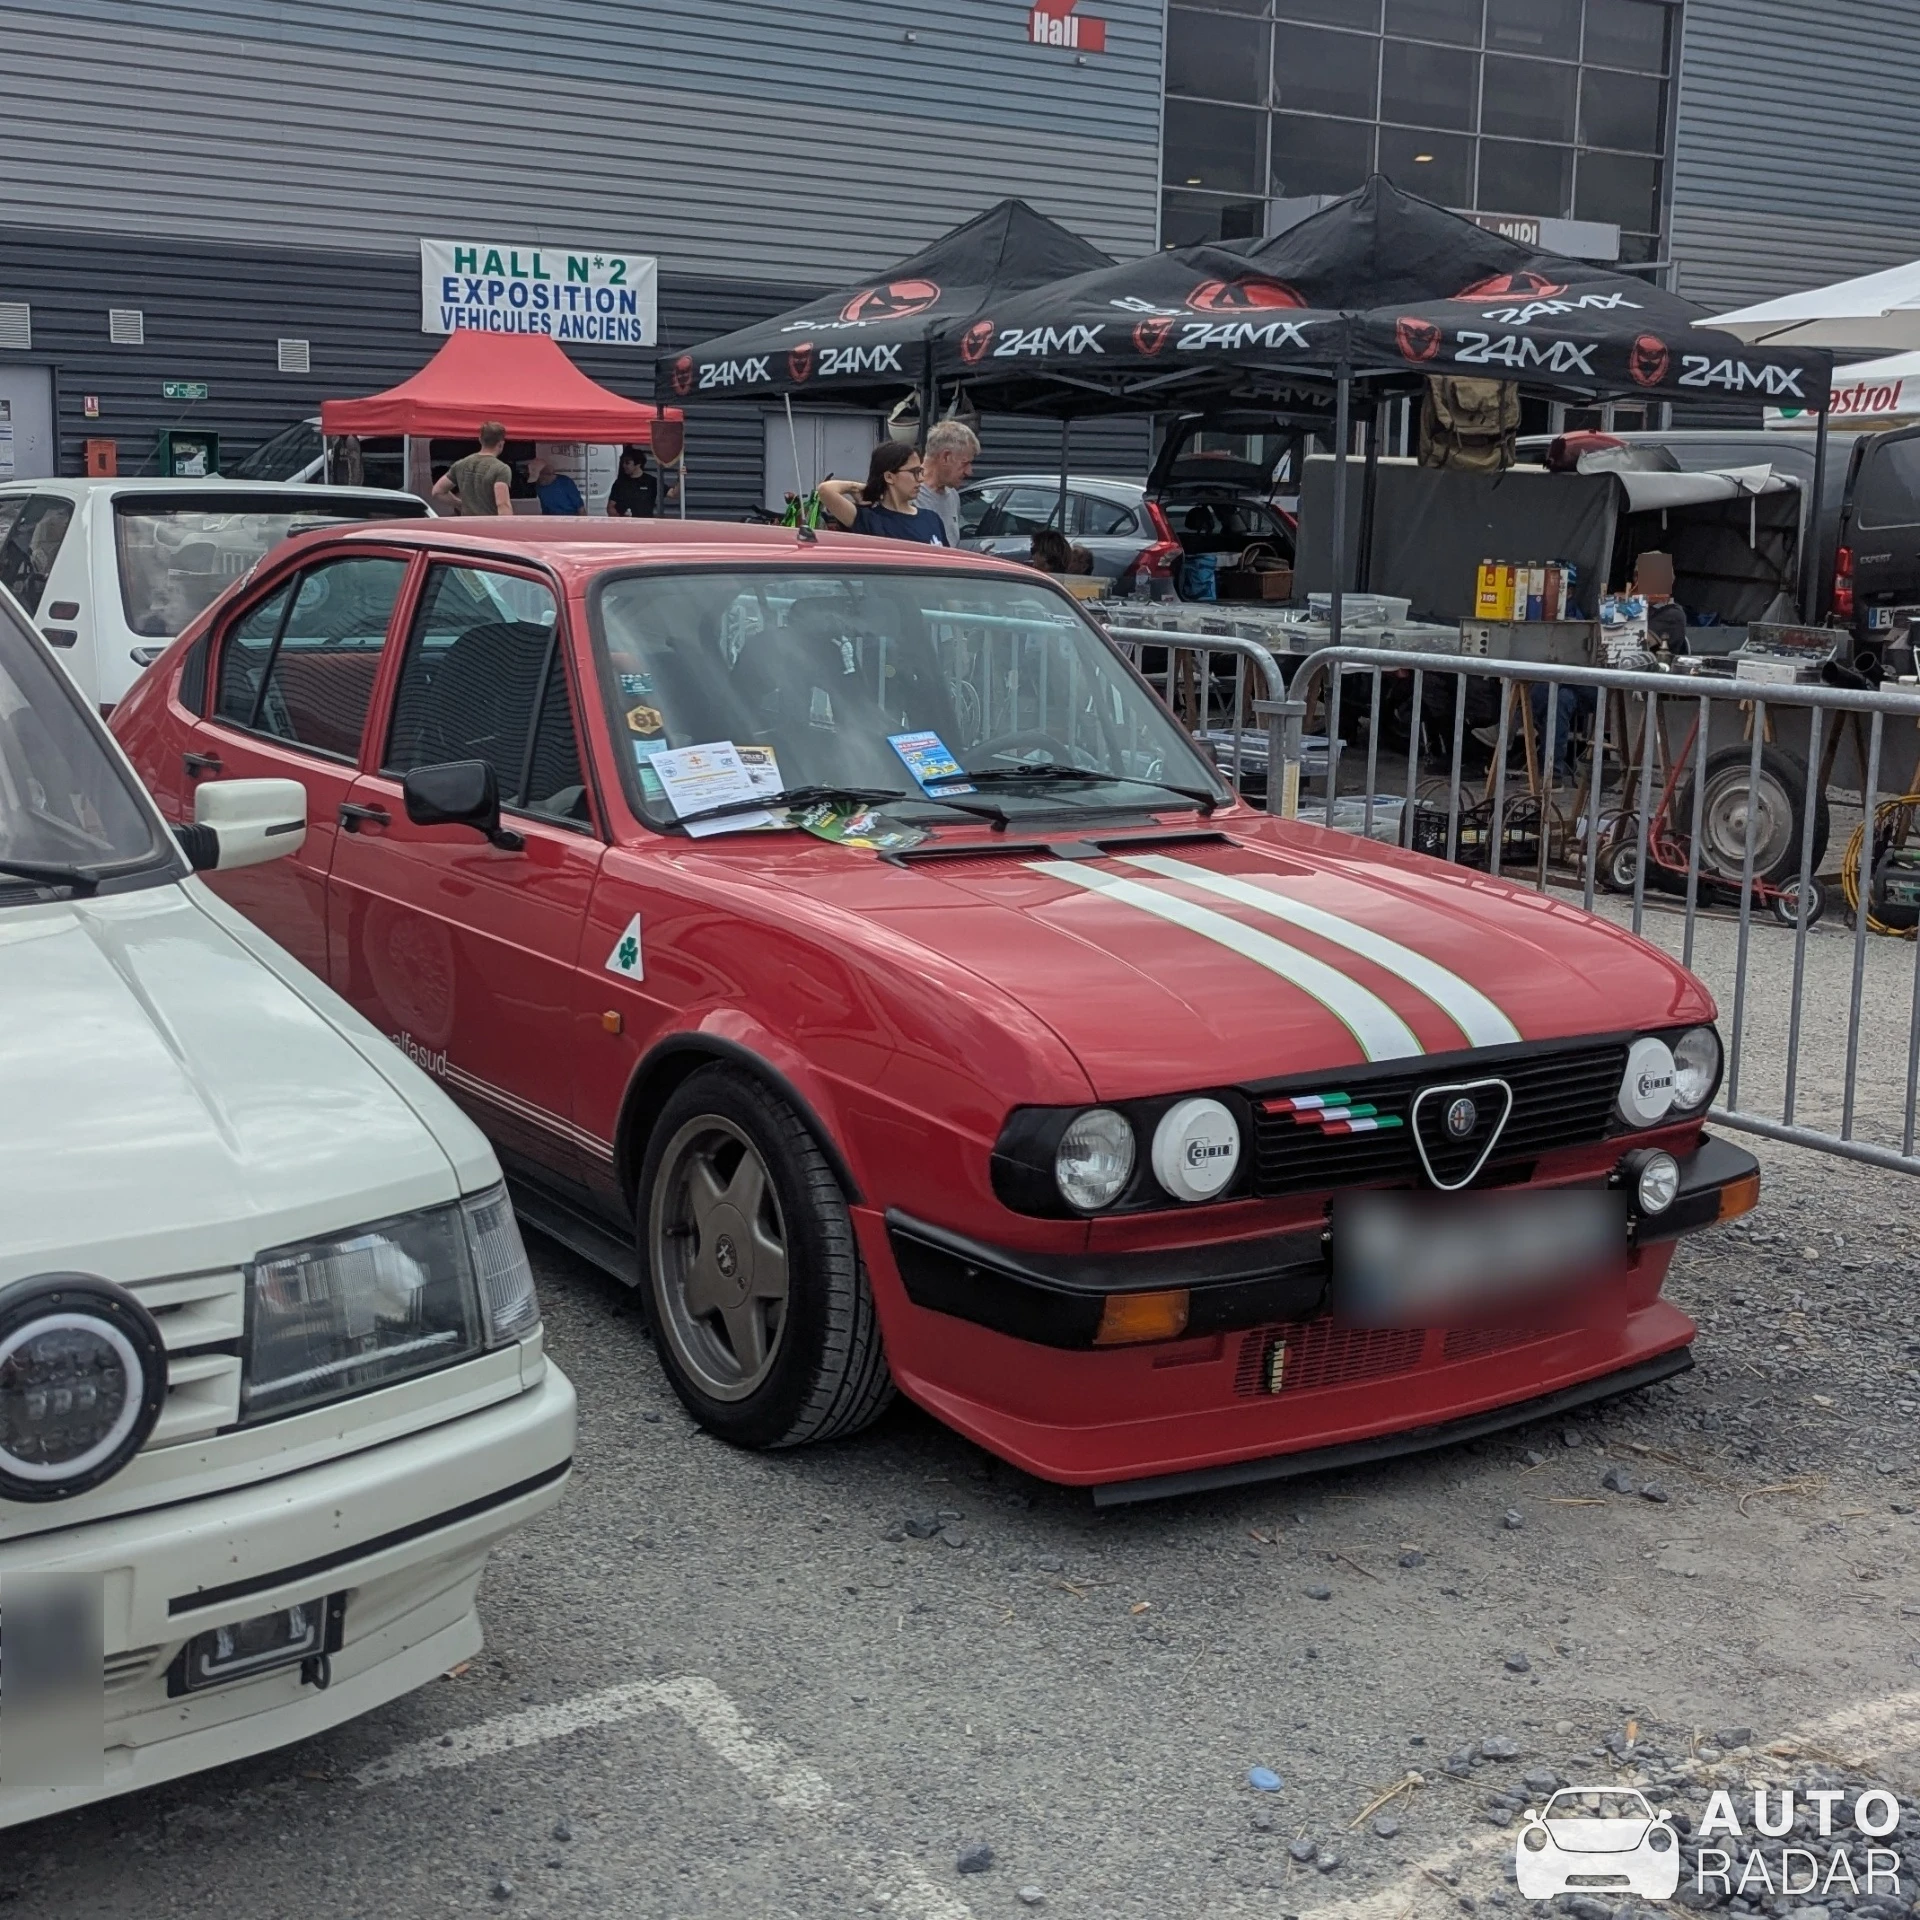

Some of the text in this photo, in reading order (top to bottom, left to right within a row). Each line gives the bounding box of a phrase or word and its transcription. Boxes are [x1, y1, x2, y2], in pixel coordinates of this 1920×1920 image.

[1033, 11, 1079, 49] Hall
[1498, 222, 1537, 246] MIDI
[454, 246, 551, 280] HALL
[442, 276, 637, 315] EXPOSITION
[440, 305, 642, 343] VEHICULES ANCIENS
[993, 323, 1106, 357] 24MX
[1176, 320, 1317, 350] 24MX
[818, 343, 902, 376] 24MX
[1454, 331, 1599, 376] 24MX
[698, 355, 772, 389] 24MX
[1678, 355, 1806, 398] 24MX
[633, 711, 660, 728] 81
[391, 1030, 447, 1077] alfasud
